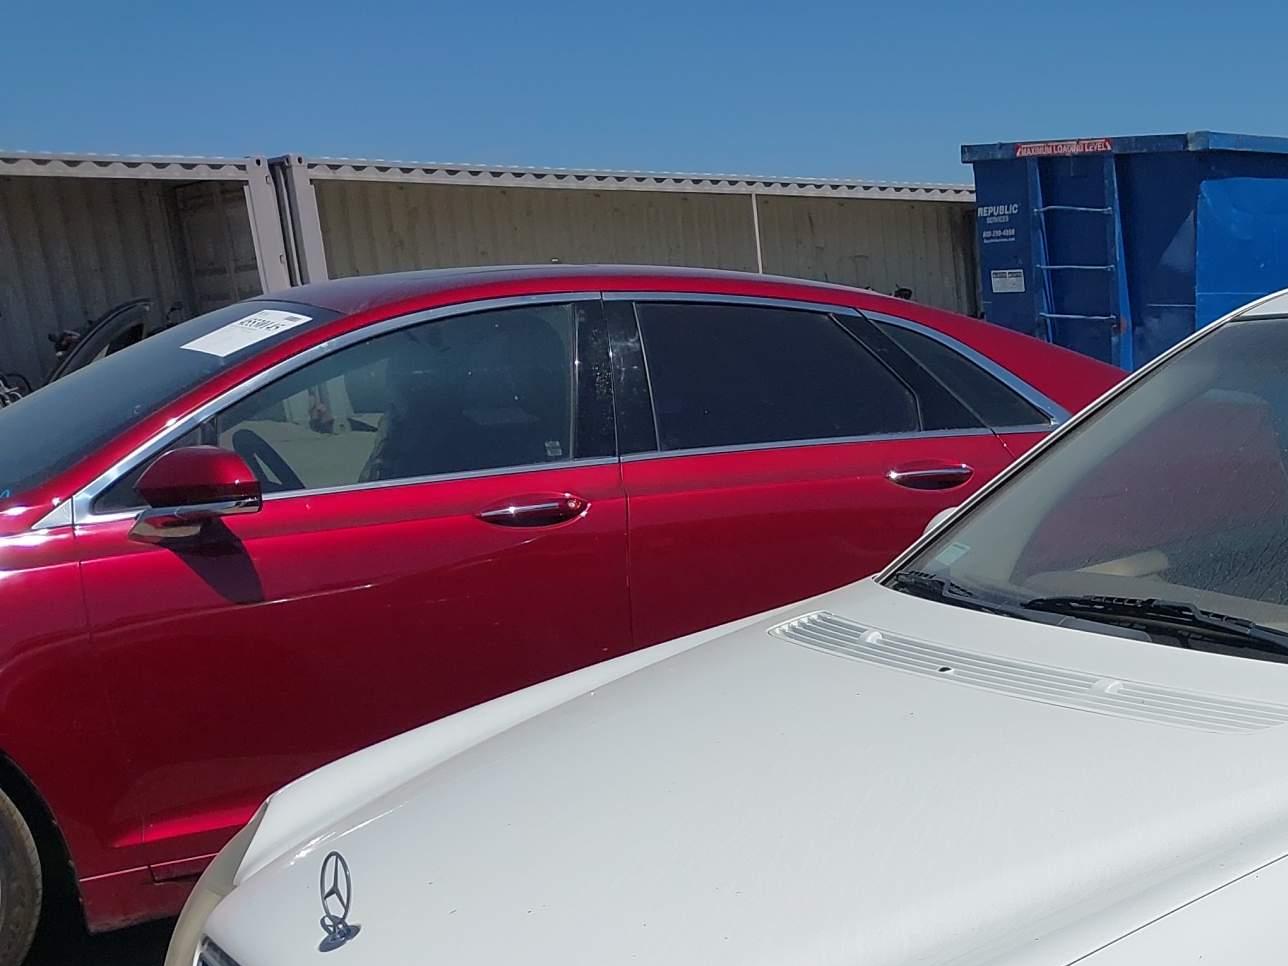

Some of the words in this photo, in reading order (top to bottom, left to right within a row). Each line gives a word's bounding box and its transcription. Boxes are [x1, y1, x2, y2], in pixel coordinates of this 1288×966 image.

[1021, 145, 1052, 156] MAXIMUM
[1053, 143, 1083, 154] LOADING
[1084, 142, 1106, 152] LEVEL
[977, 203, 1019, 217] REPUBLIC
